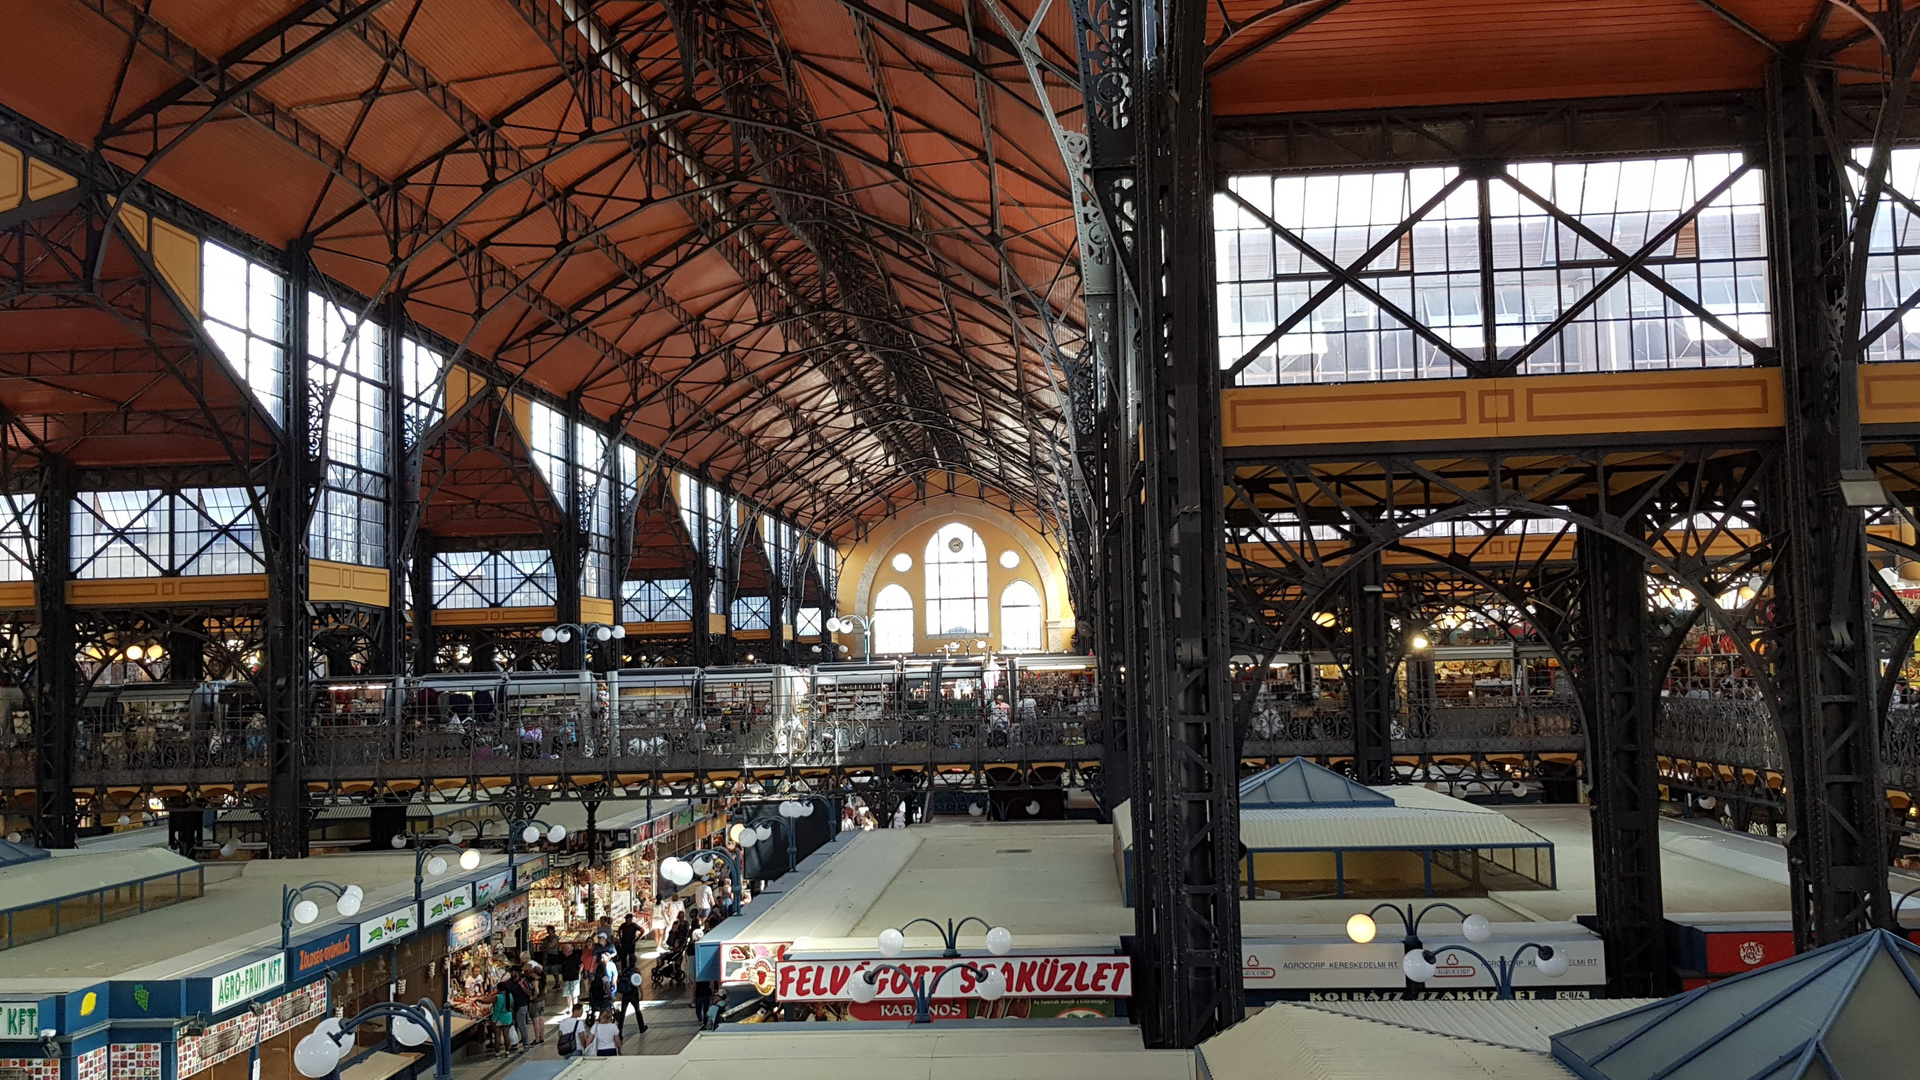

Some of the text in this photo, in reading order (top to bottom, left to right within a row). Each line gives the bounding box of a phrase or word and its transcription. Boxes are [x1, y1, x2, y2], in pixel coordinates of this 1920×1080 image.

[960, 957, 1130, 994] SAKÜZLET
[1329, 961, 1385, 969] KERESKEDELMI
[218, 958, 283, 1006] AGRO-FRUIT KFT.
[1416, 989, 1538, 1001] SZAKÜZET
[880, 1003, 962, 1017] KABNOS
[7, 1008, 38, 1036] KFT.
